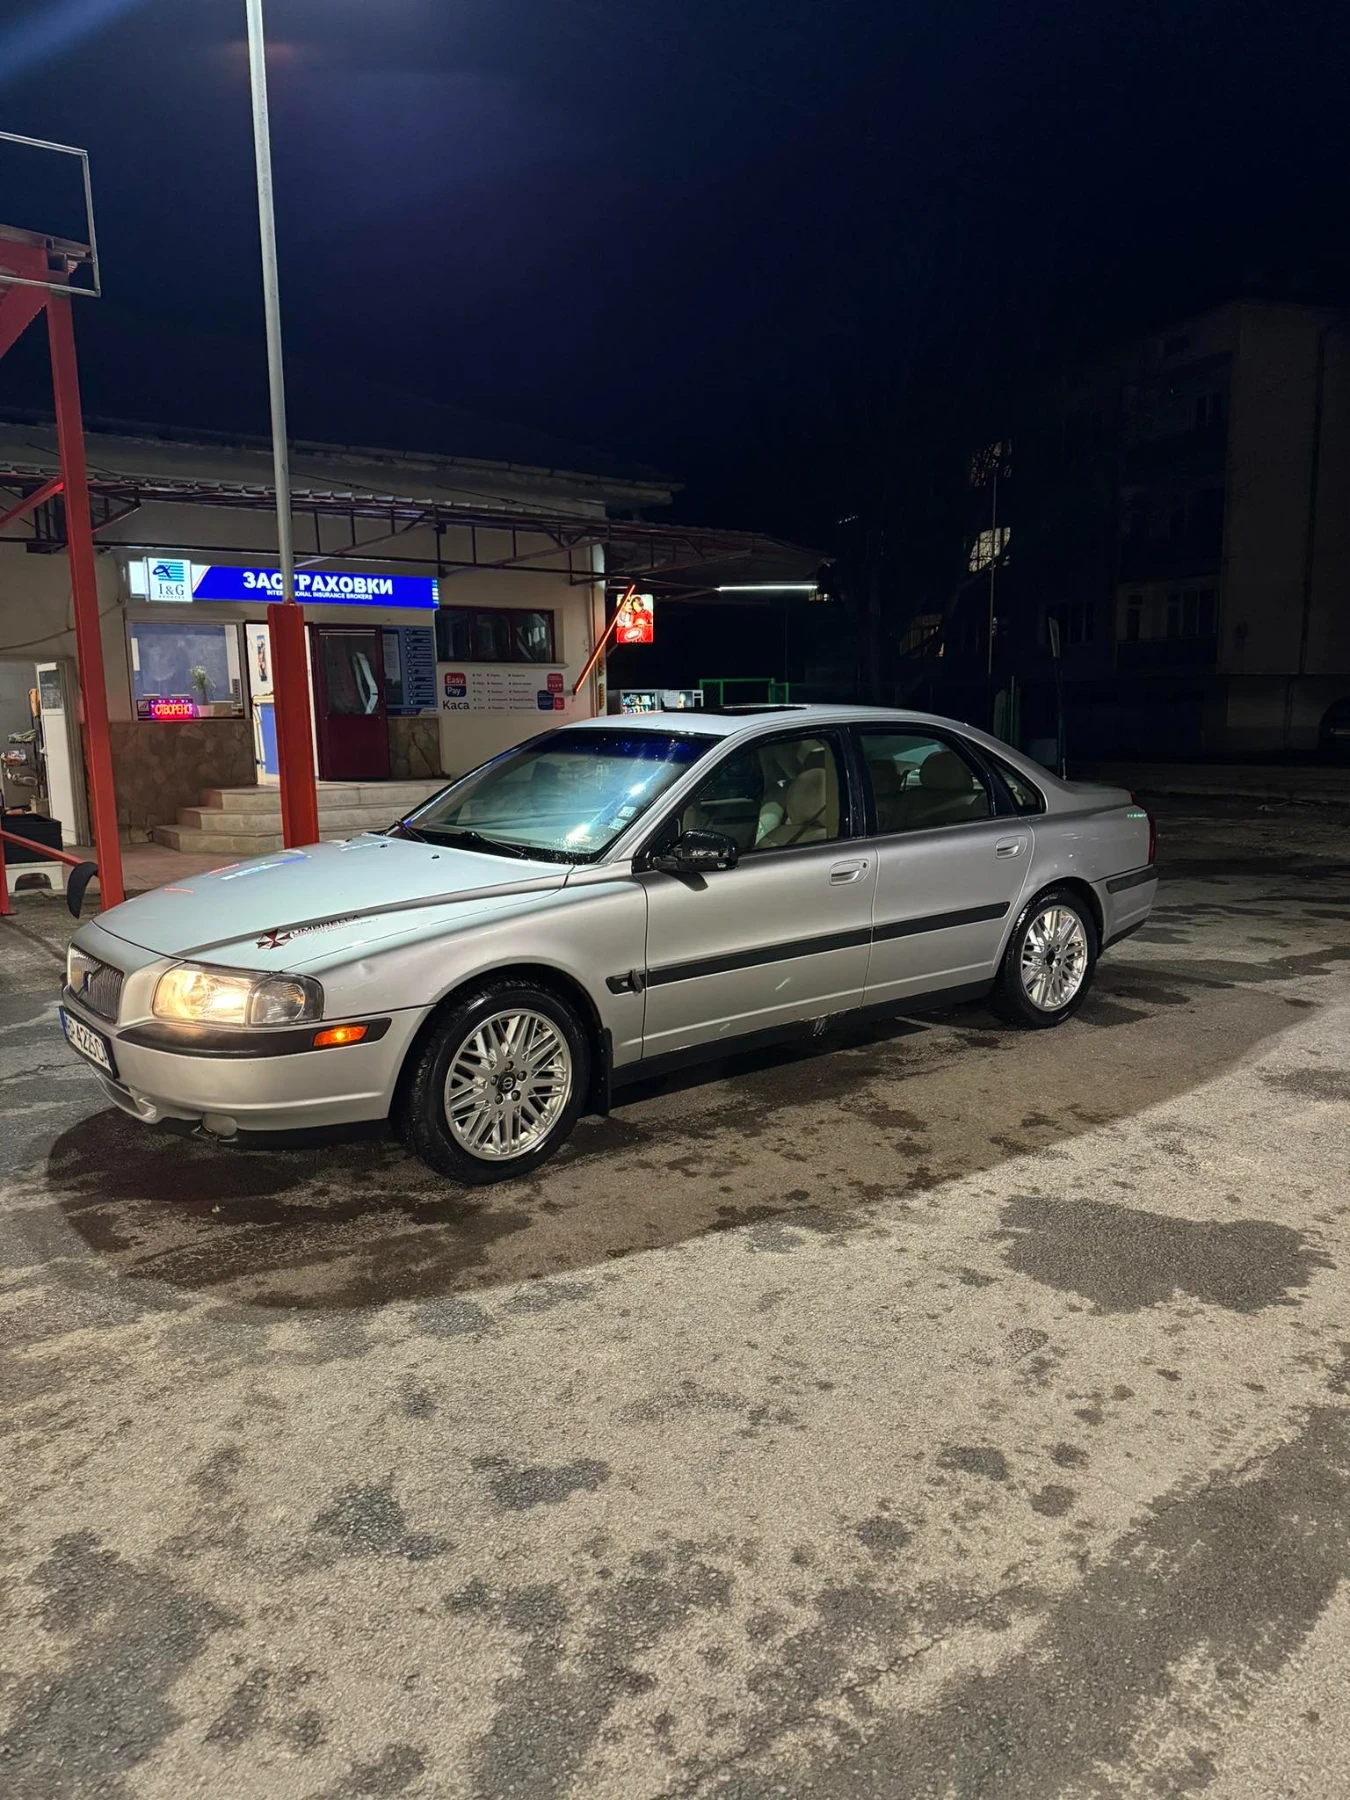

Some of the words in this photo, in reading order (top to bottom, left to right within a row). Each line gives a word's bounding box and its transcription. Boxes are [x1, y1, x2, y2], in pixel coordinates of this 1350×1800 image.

[243, 572, 393, 595] ЗАСРАХОВКИ
[313, 591, 345, 599] INSURANCE
[446, 675, 464, 685] Easy
[447, 687, 461, 696] Pay
